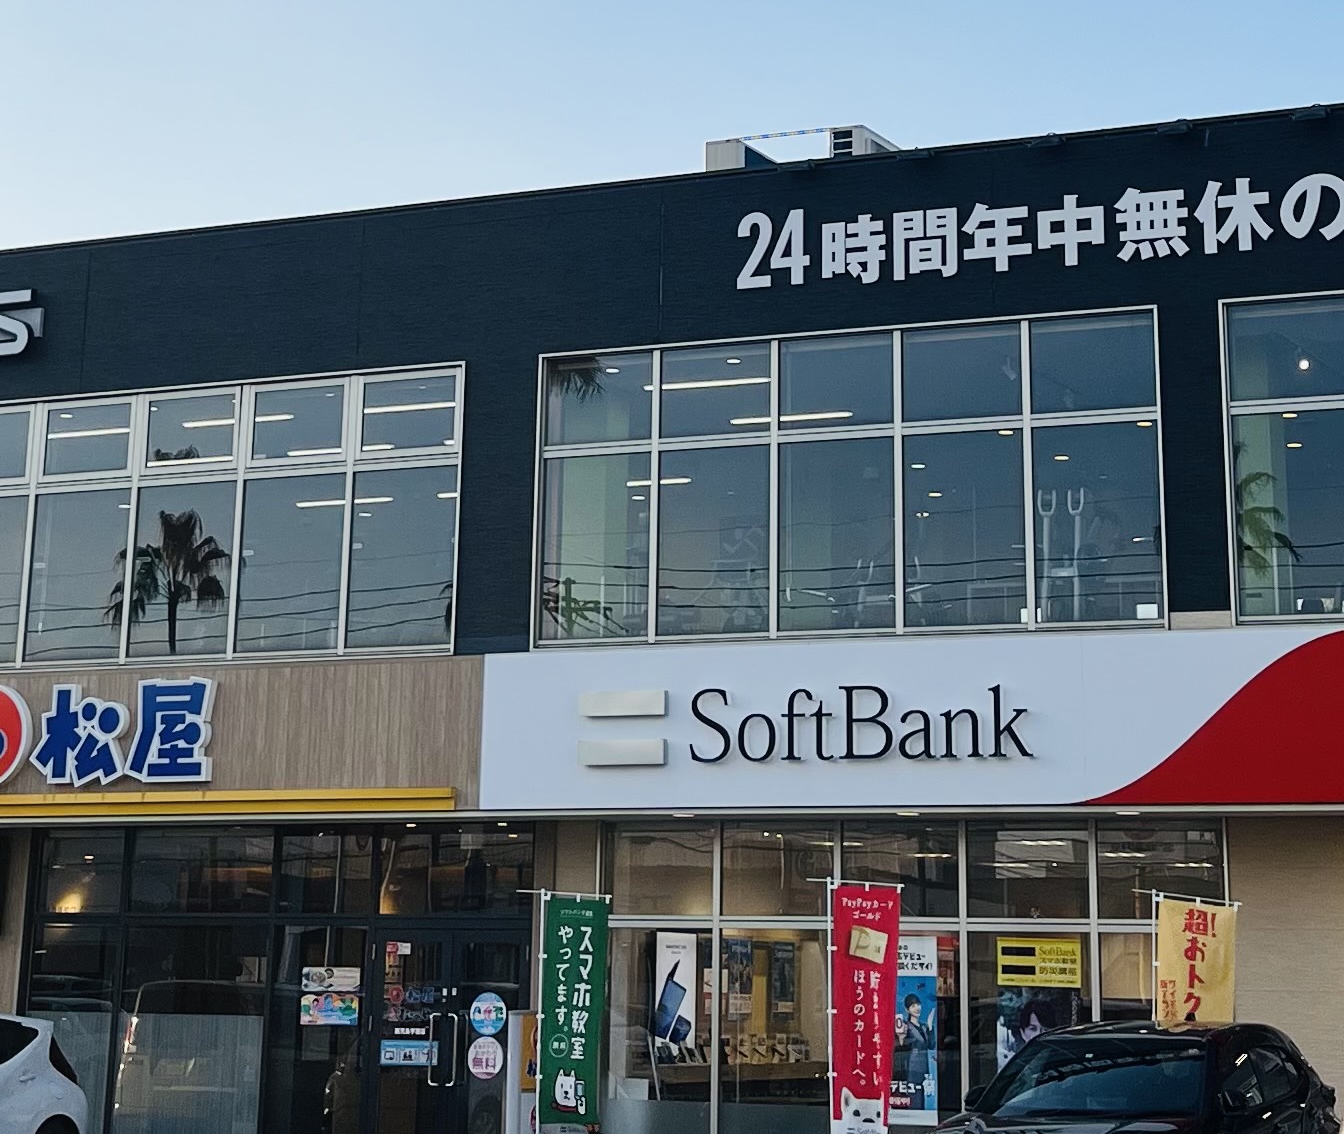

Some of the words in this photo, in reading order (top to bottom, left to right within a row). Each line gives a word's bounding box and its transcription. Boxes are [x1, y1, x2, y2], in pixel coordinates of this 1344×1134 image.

[33, 677, 213, 786] 松屋
[689, 683, 1035, 763] SoftBank
[555, 925, 575, 1032] やってます。
[570, 926, 594, 1060] スマホ教室
